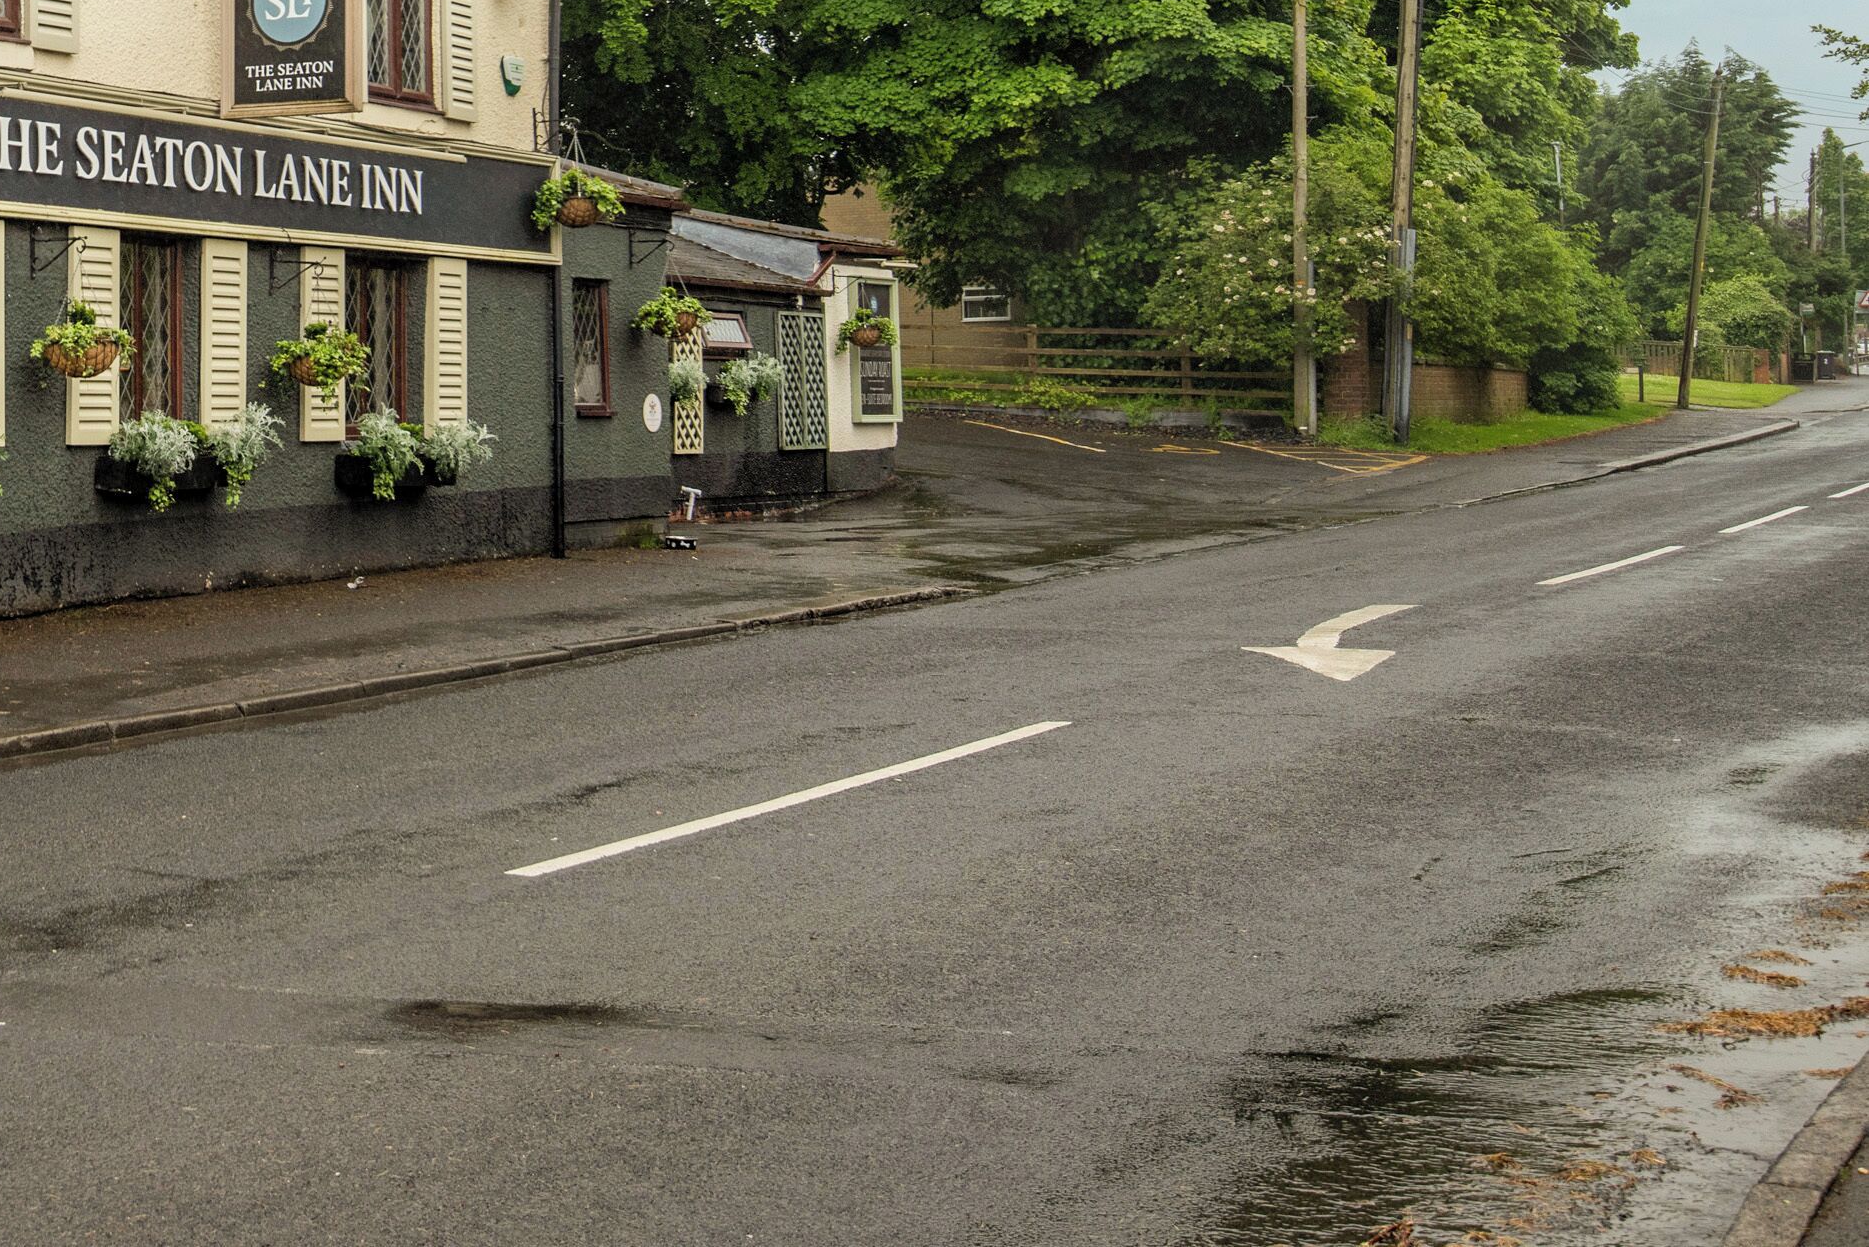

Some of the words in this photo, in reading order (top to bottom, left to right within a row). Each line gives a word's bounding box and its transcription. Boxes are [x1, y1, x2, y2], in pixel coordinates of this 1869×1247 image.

[245, 64, 274, 78] THE
[277, 60, 334, 76] SEATON
[255, 77, 293, 92] LANE
[296, 76, 323, 89] INN
[75, 125, 244, 197] SEATON
[255, 149, 352, 207] LANE
[361, 163, 424, 216] INN
